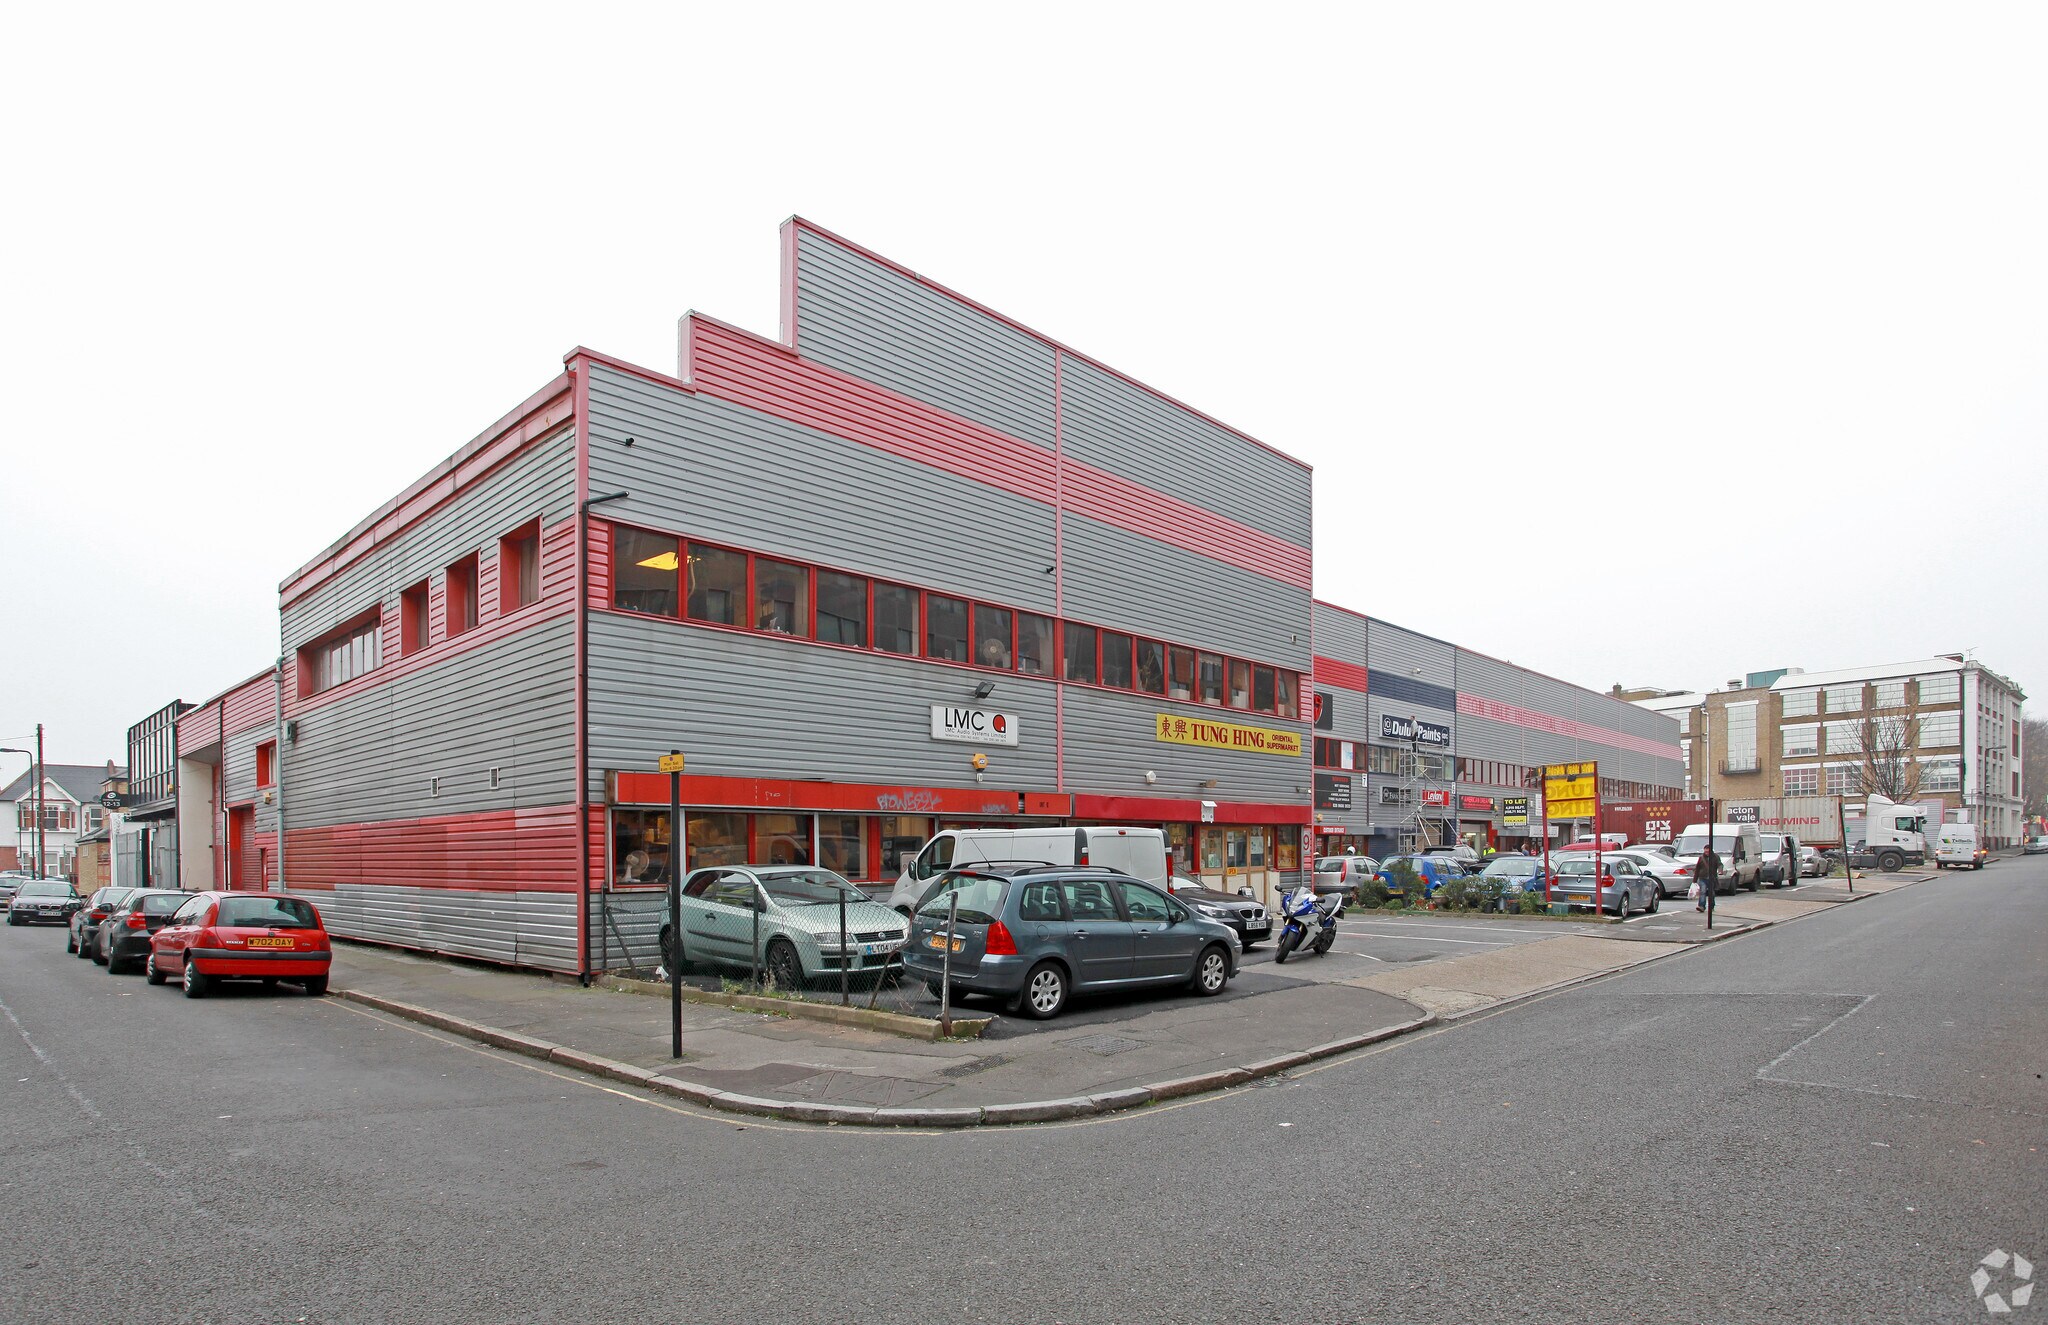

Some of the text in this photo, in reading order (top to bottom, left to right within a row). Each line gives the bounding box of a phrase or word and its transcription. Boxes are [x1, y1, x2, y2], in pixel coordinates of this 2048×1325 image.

[946, 708, 984, 731] LMC
[1160, 717, 1188, 740] 東興
[1191, 723, 1264, 748] TUNG HING
[1392, 720, 1441, 741] Dulu Paints
[1271, 734, 1293, 743] ORIENTAL
[1267, 742, 1299, 752] SUPERMARKET
[1736, 814, 1756, 822] vale
[1303, 834, 1310, 850] 9
[1646, 831, 1671, 841] ZIM
